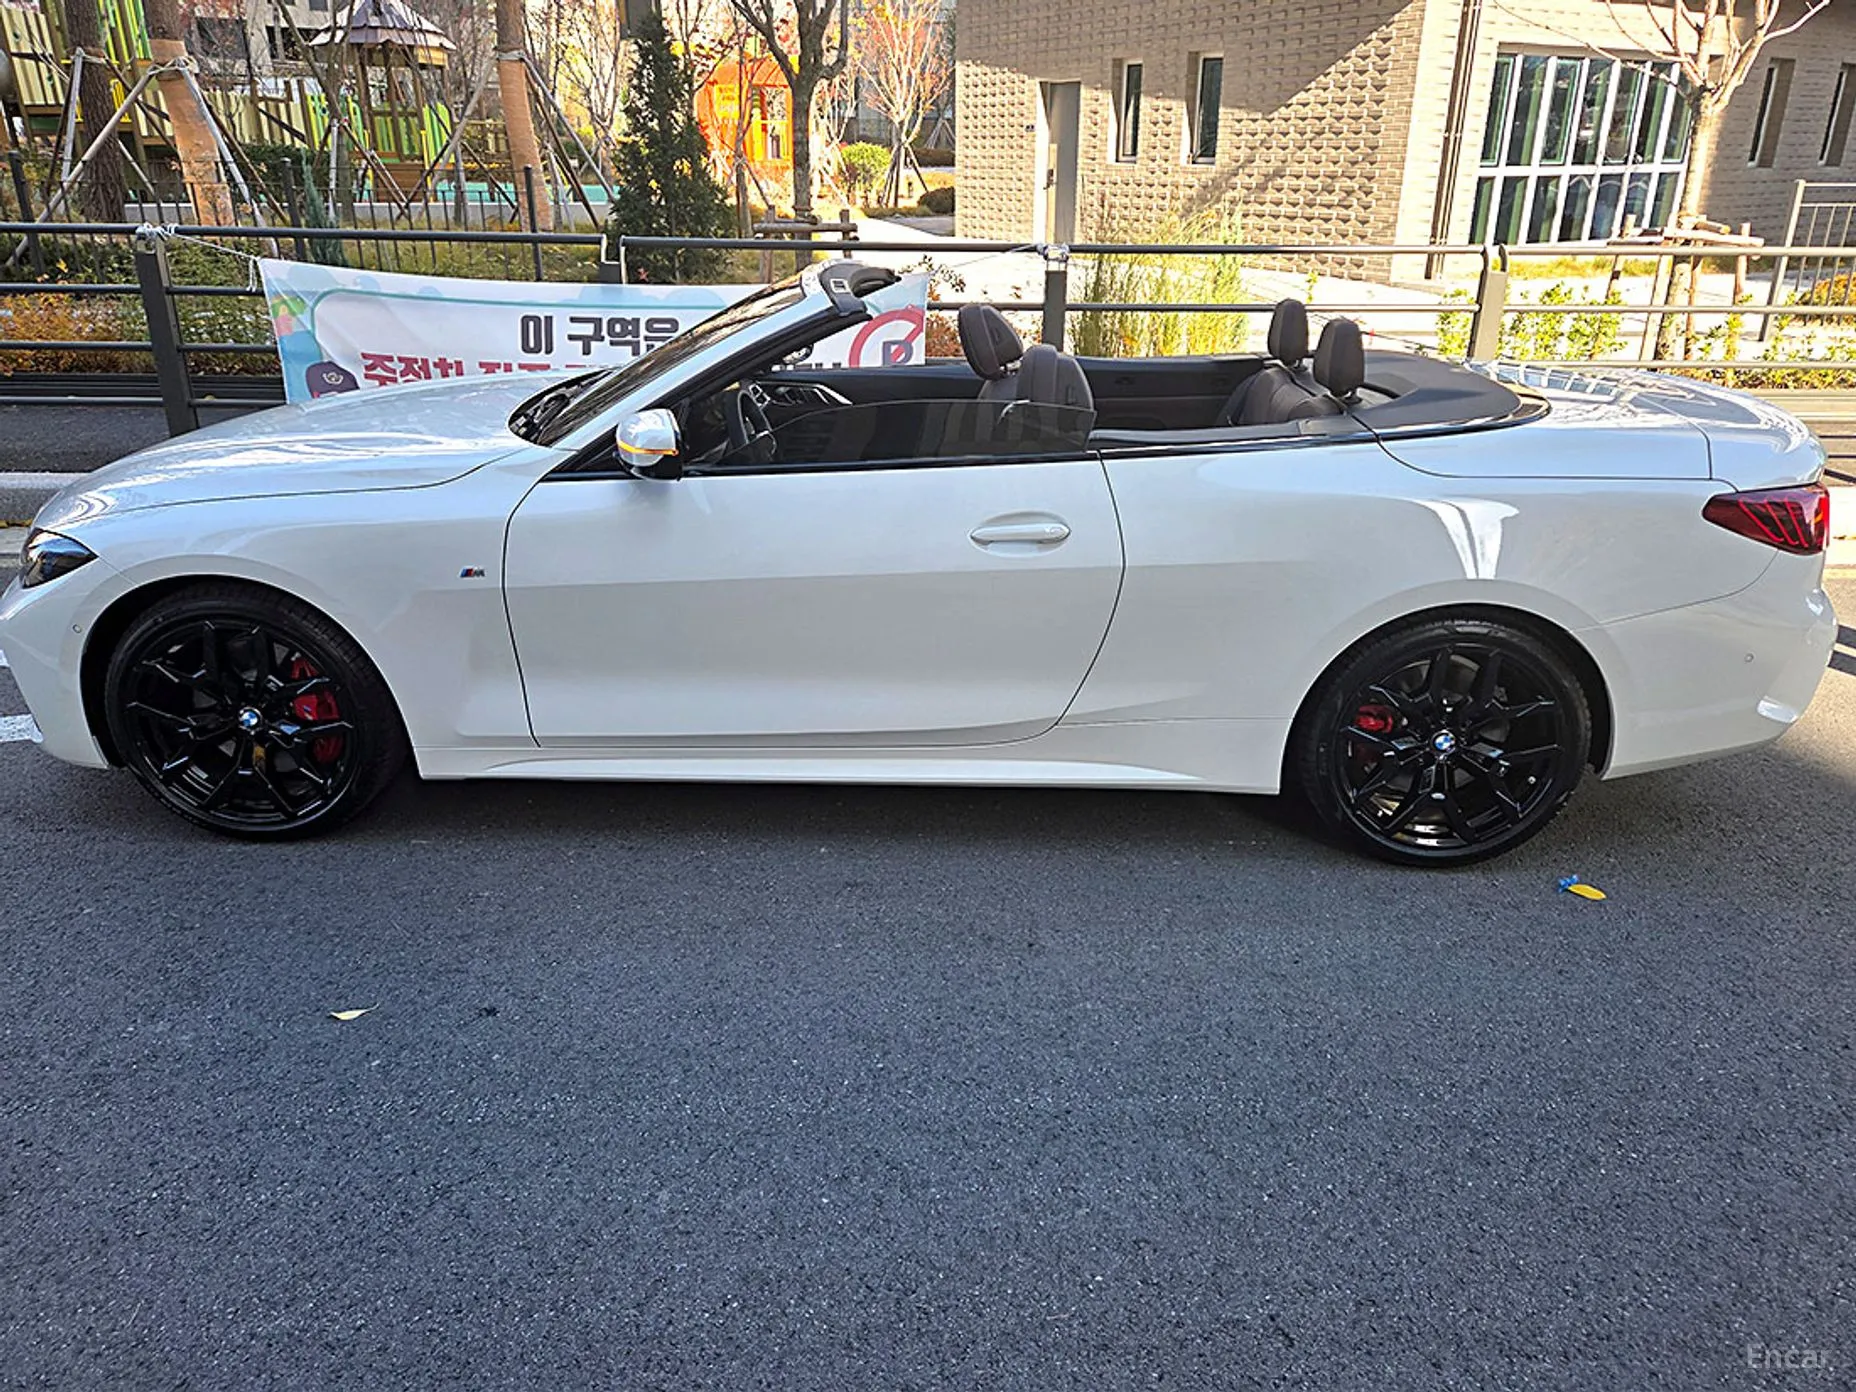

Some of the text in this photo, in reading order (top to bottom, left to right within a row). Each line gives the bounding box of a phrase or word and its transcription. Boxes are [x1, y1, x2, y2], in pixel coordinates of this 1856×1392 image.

[521, 314, 680, 357] 이 구역은
[882, 339, 914, 367] P
